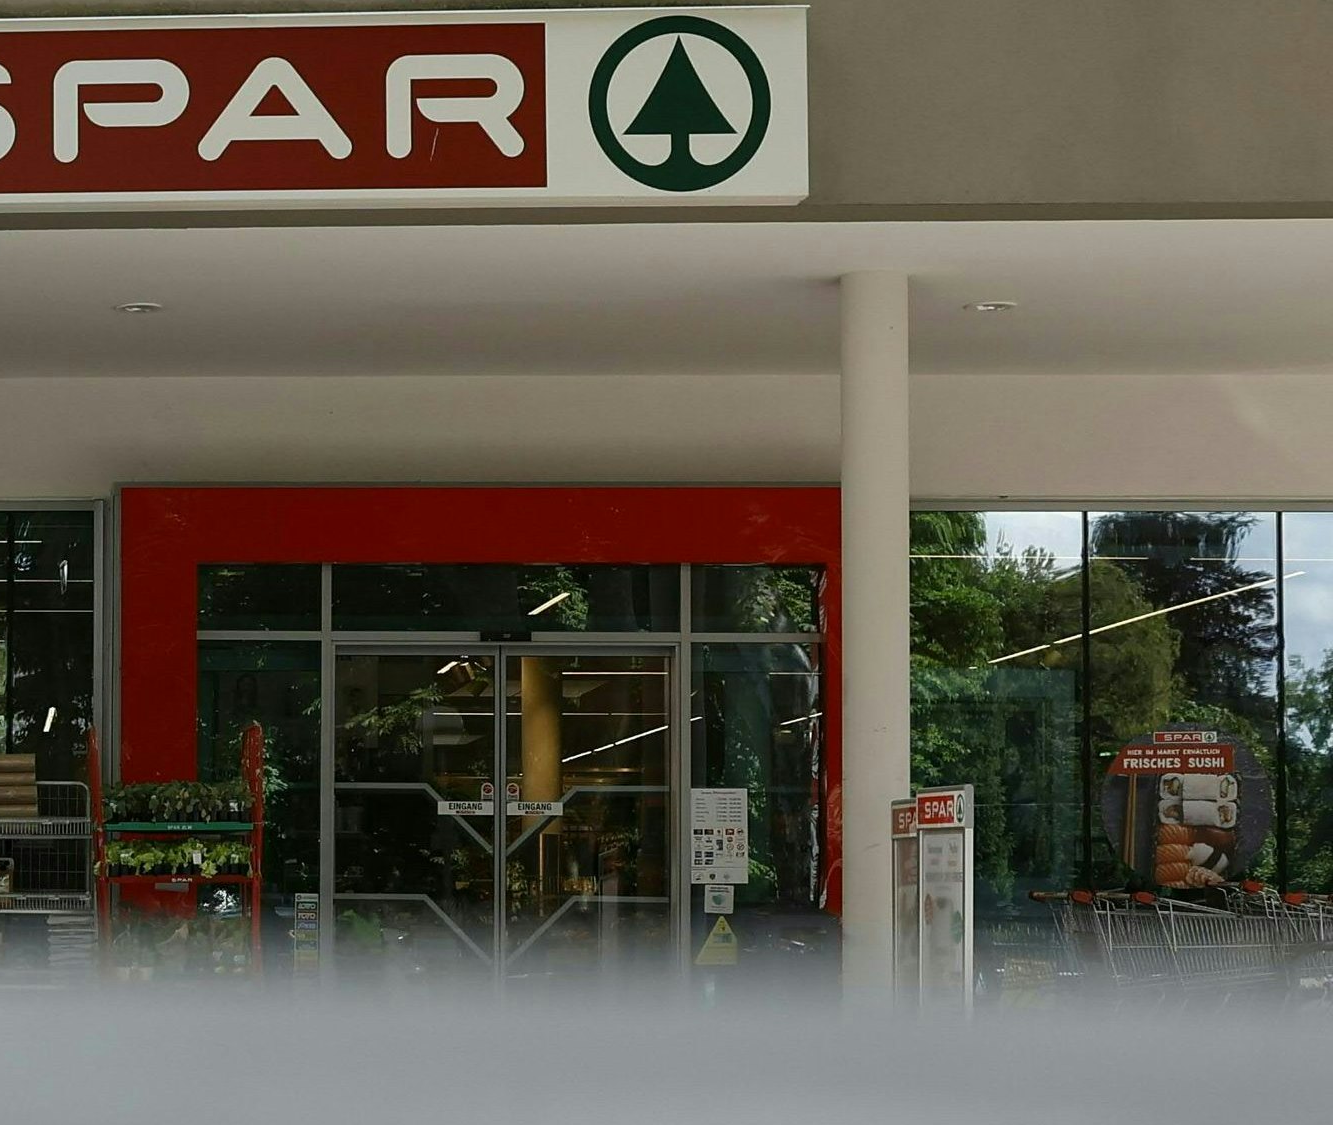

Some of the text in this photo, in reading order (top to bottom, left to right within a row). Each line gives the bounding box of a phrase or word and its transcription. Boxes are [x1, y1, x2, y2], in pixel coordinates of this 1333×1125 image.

[1164, 733, 1202, 741] SPAR
[1123, 757, 1225, 769] FRISCHES SUSHI
[448, 802, 483, 810] EINGANG
[517, 803, 552, 811] EINGANG
[924, 800, 954, 819] SPAR
